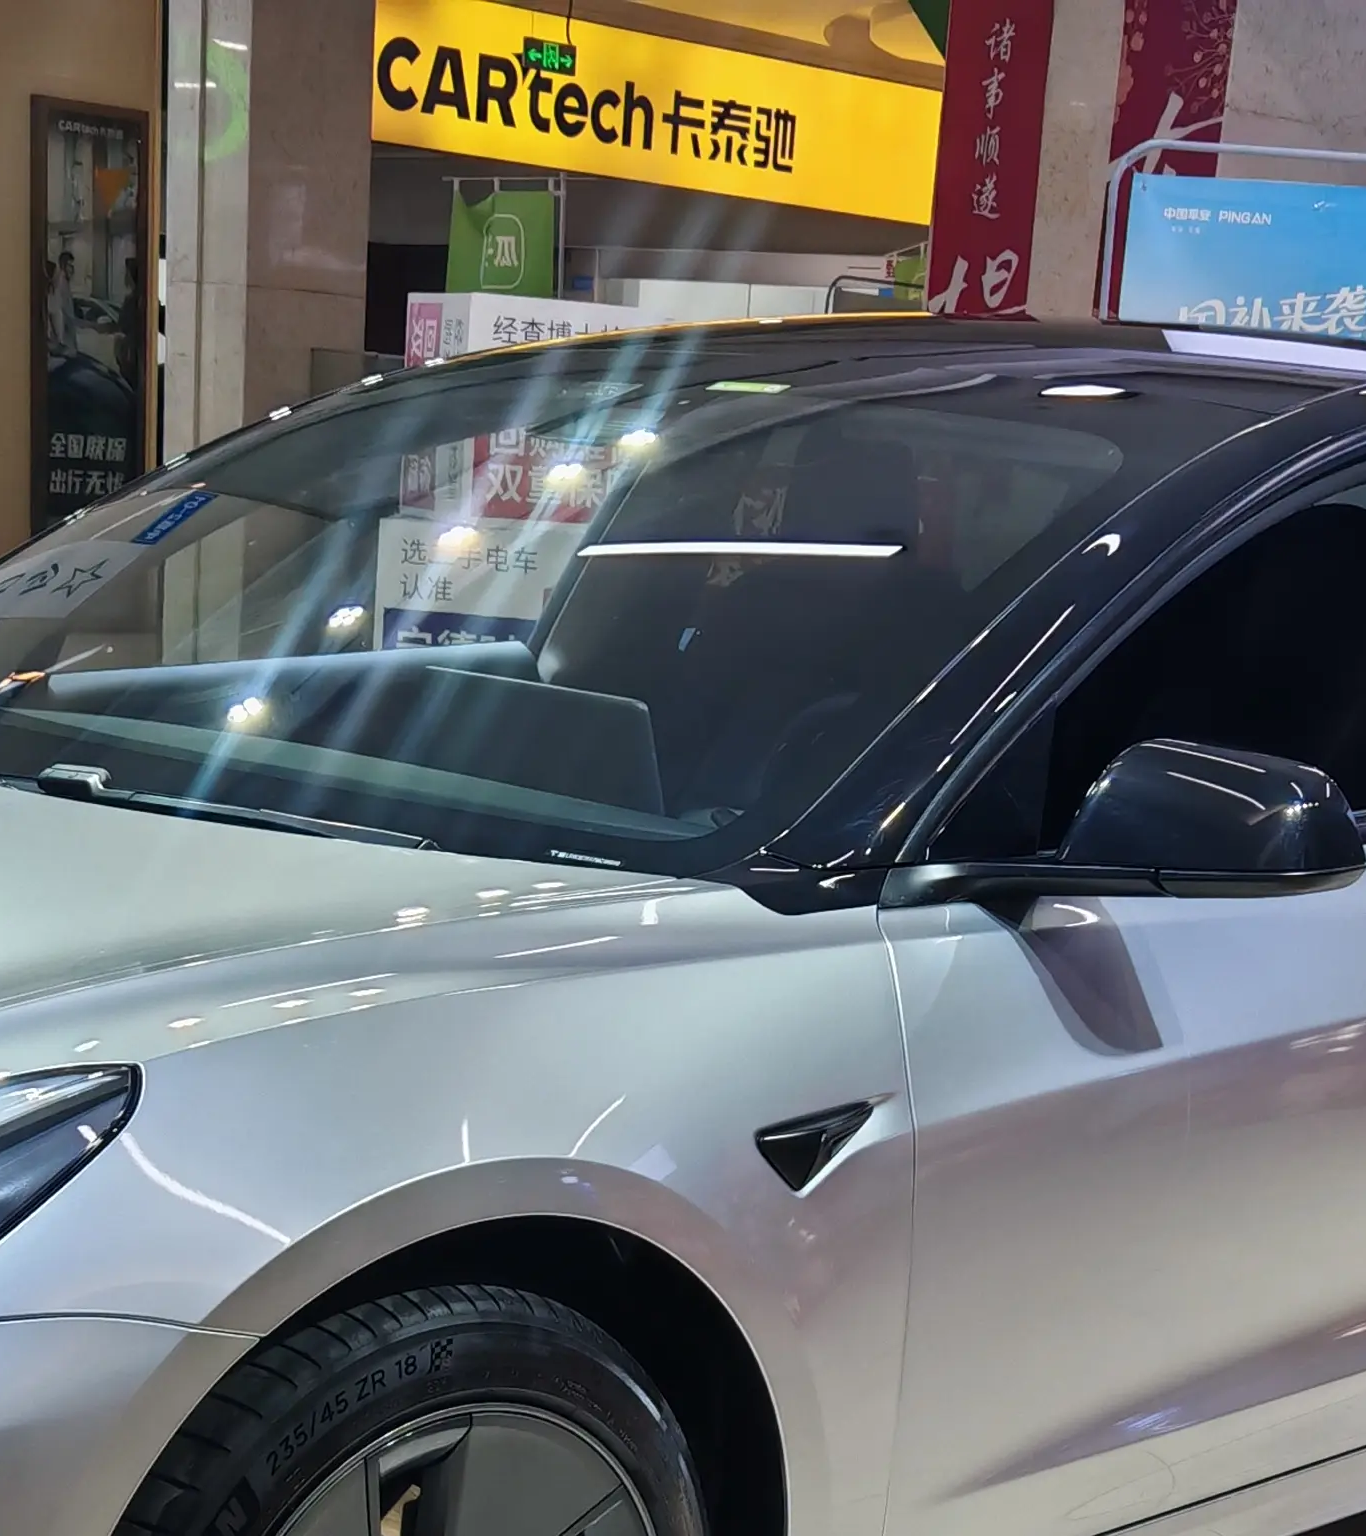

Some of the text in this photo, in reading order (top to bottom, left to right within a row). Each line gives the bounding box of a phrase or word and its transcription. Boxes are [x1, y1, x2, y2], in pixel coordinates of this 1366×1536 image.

[662, 88, 797, 174] 卡泰驰
[400, 574, 453, 603] 认准
[265, 1354, 419, 1477] 235/45 ZR 18
